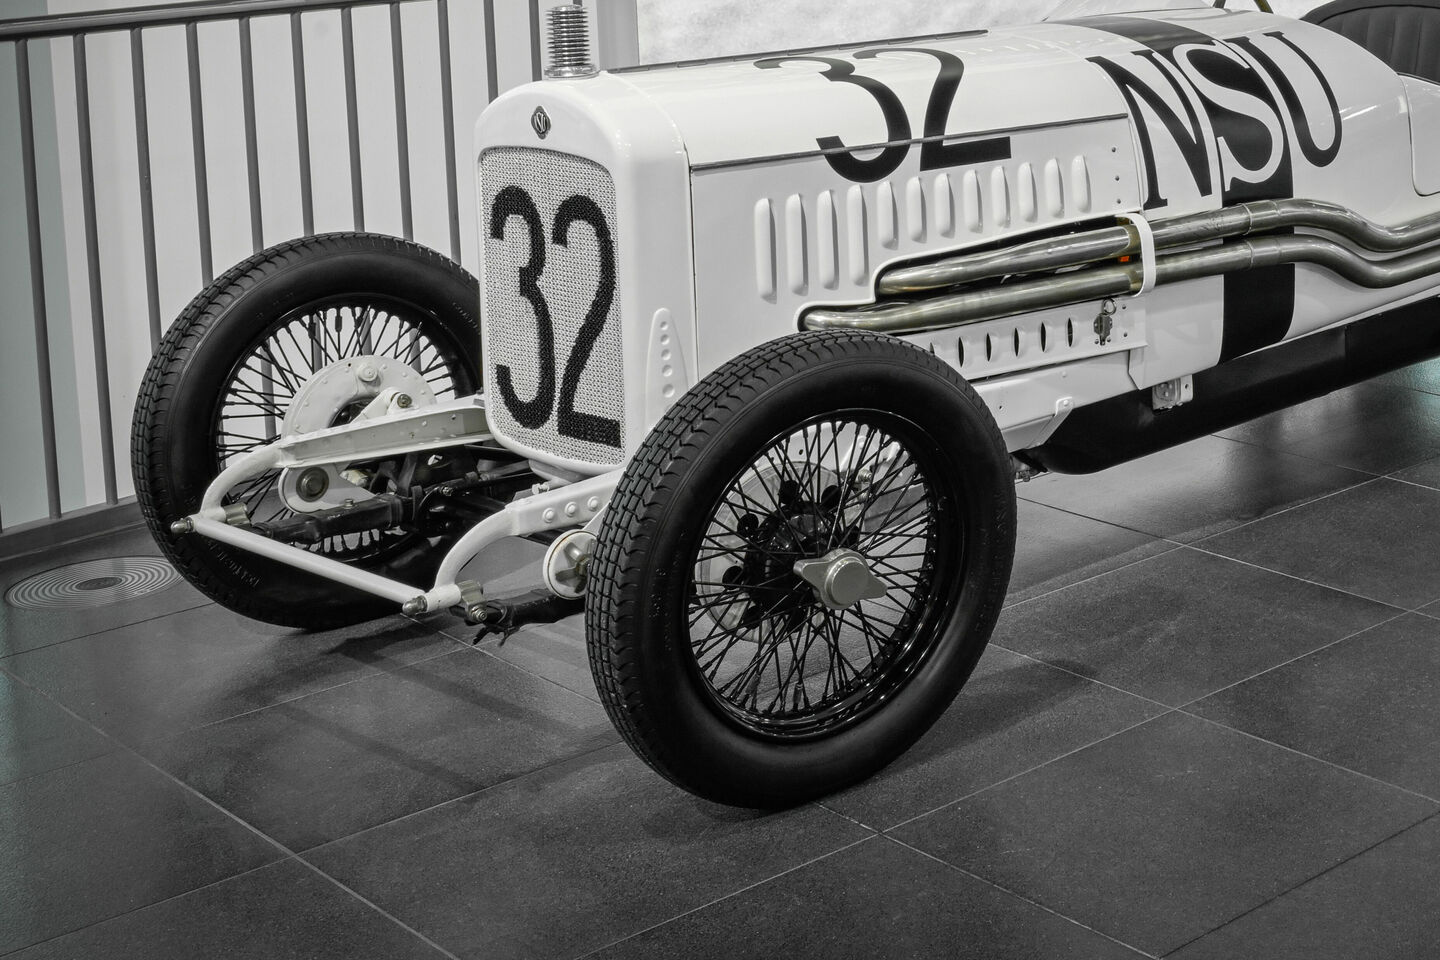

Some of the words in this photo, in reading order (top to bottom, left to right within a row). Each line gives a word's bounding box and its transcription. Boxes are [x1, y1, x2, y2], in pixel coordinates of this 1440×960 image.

[753, 47, 1012, 183] 32
[1085, 31, 1343, 211] NSU
[489, 185, 622, 448] 32
